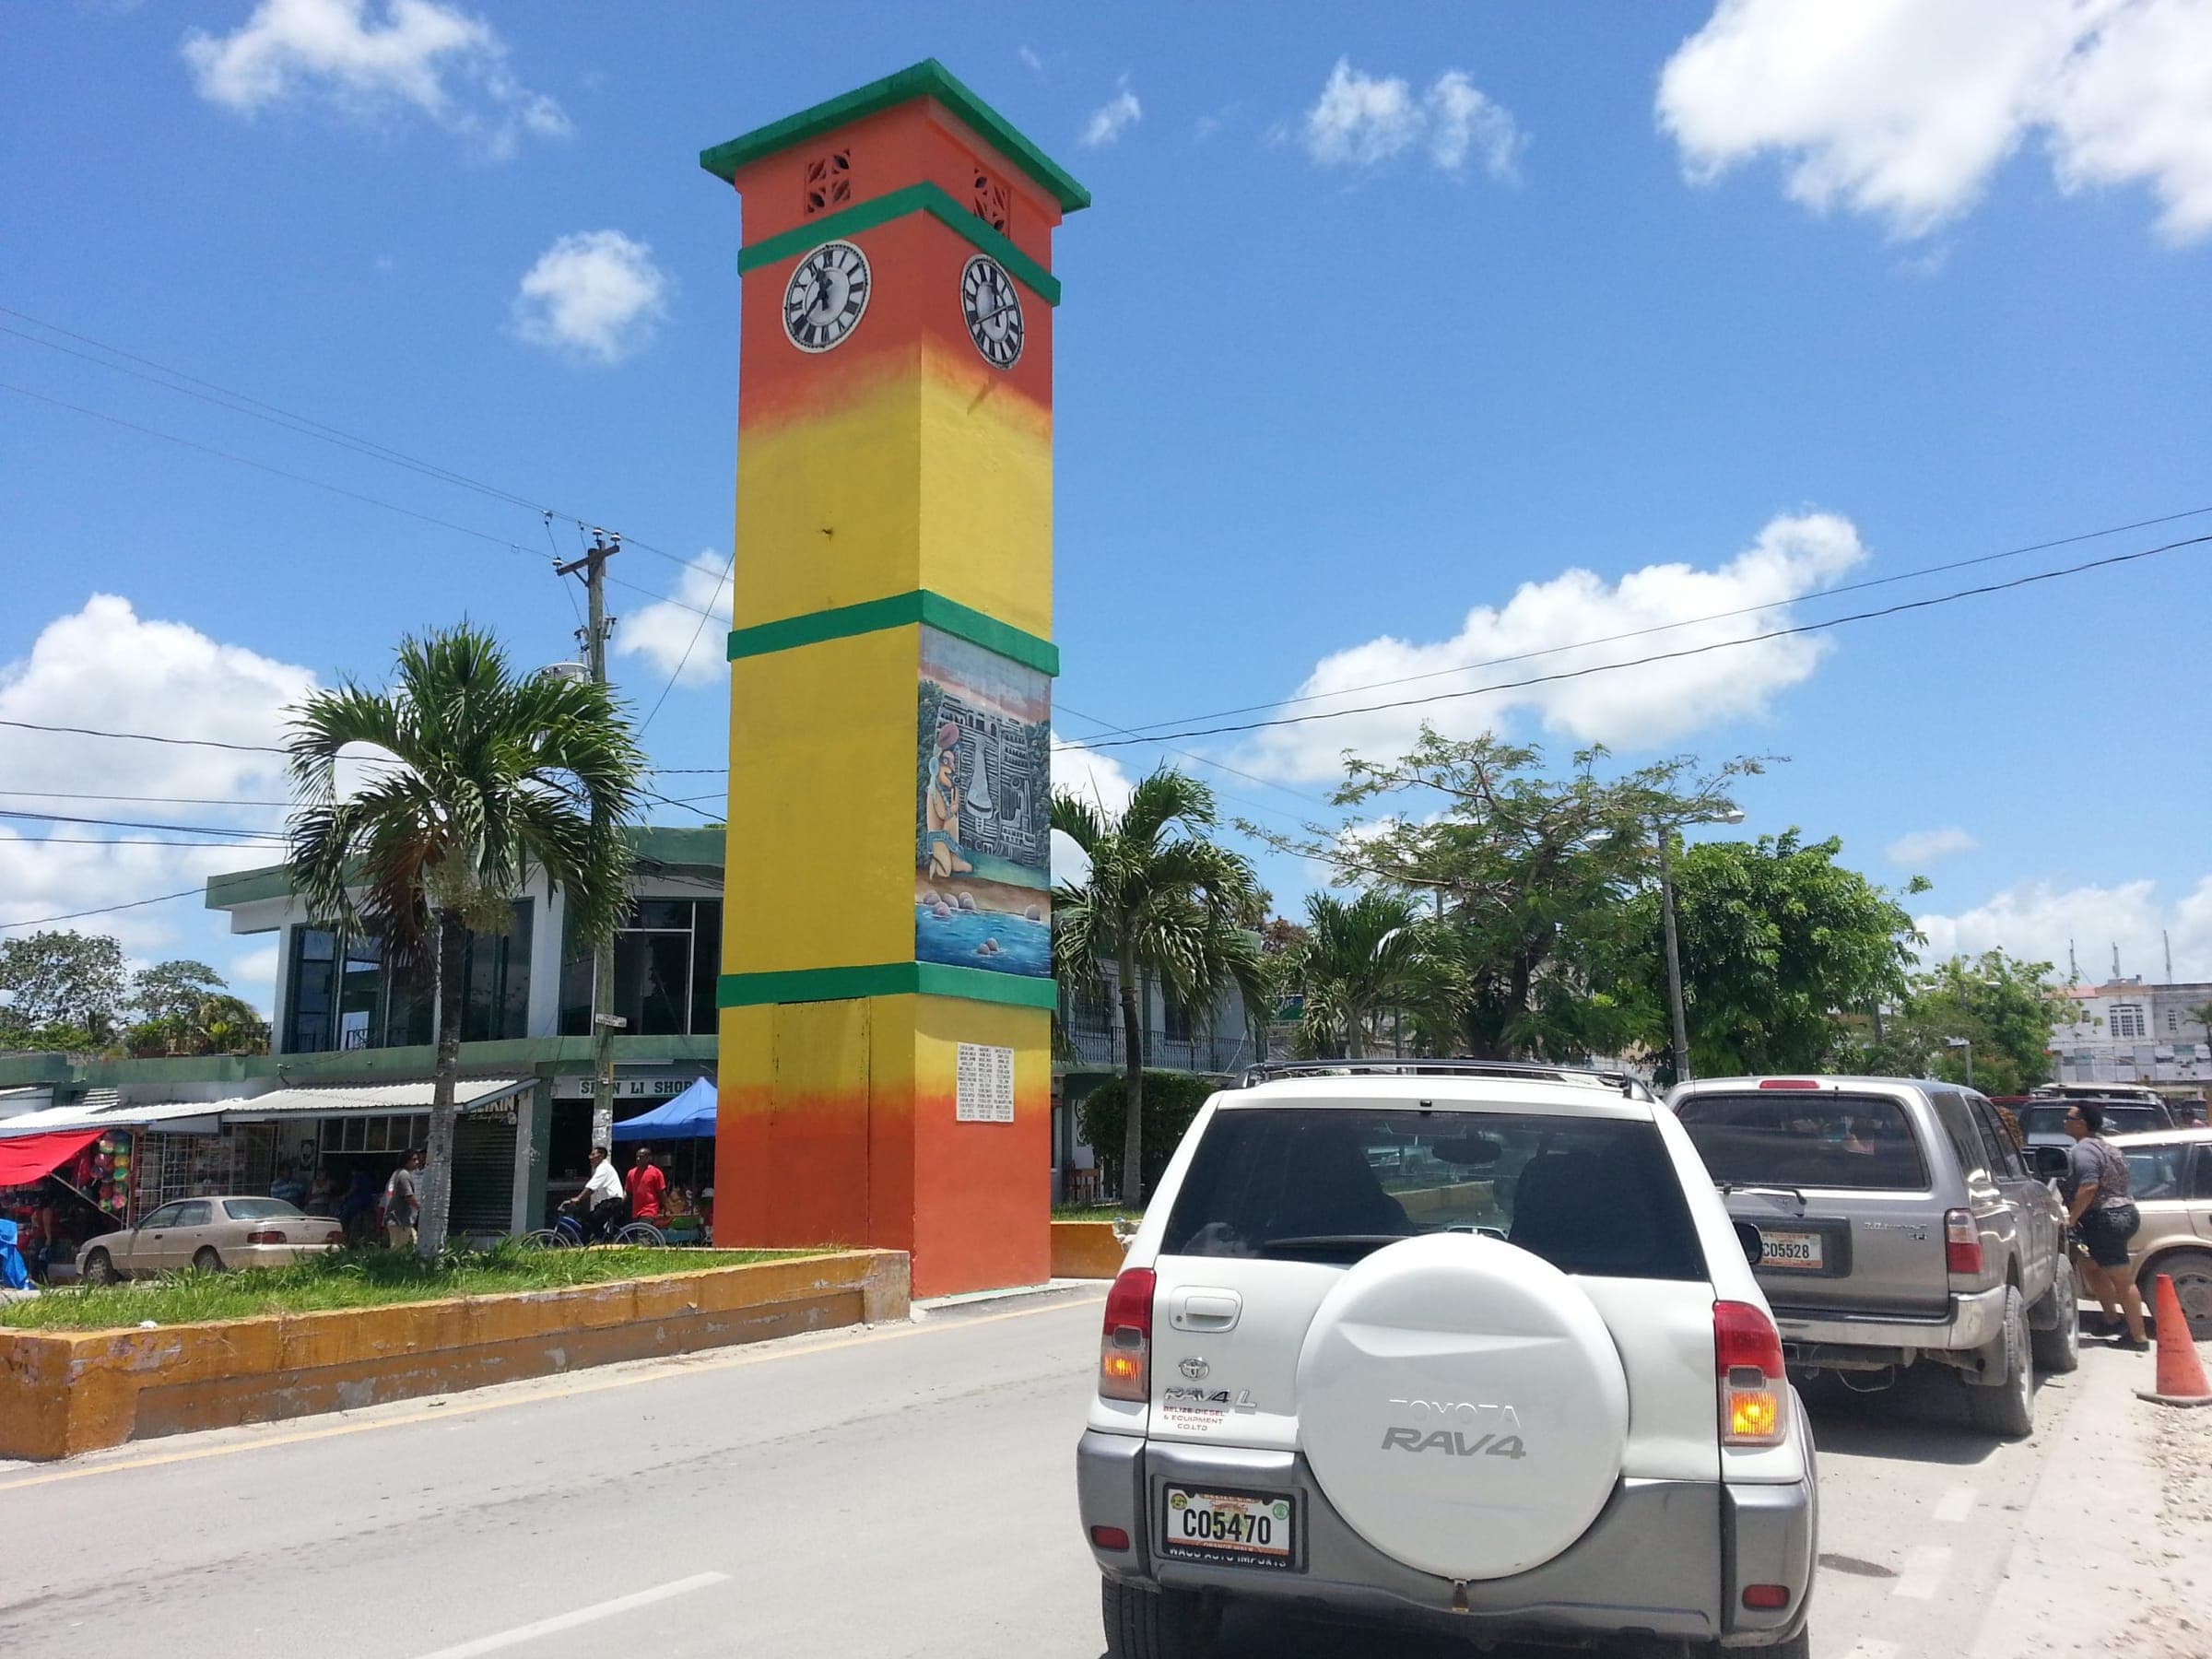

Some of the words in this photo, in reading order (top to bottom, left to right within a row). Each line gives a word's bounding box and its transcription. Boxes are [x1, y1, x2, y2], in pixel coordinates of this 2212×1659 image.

[581, 1081, 621, 1094] SN
[630, 1081, 644, 1094] LI
[1164, 1388, 1230, 1403] RAV4
[1236, 1389, 1257, 1408] L
[1163, 1405, 1193, 1413] BELIZE
[1194, 1407, 1225, 1417] DIESEL
[1171, 1415, 1223, 1424] EQUIPMENT
[1381, 1426, 1527, 1460] RAV4
